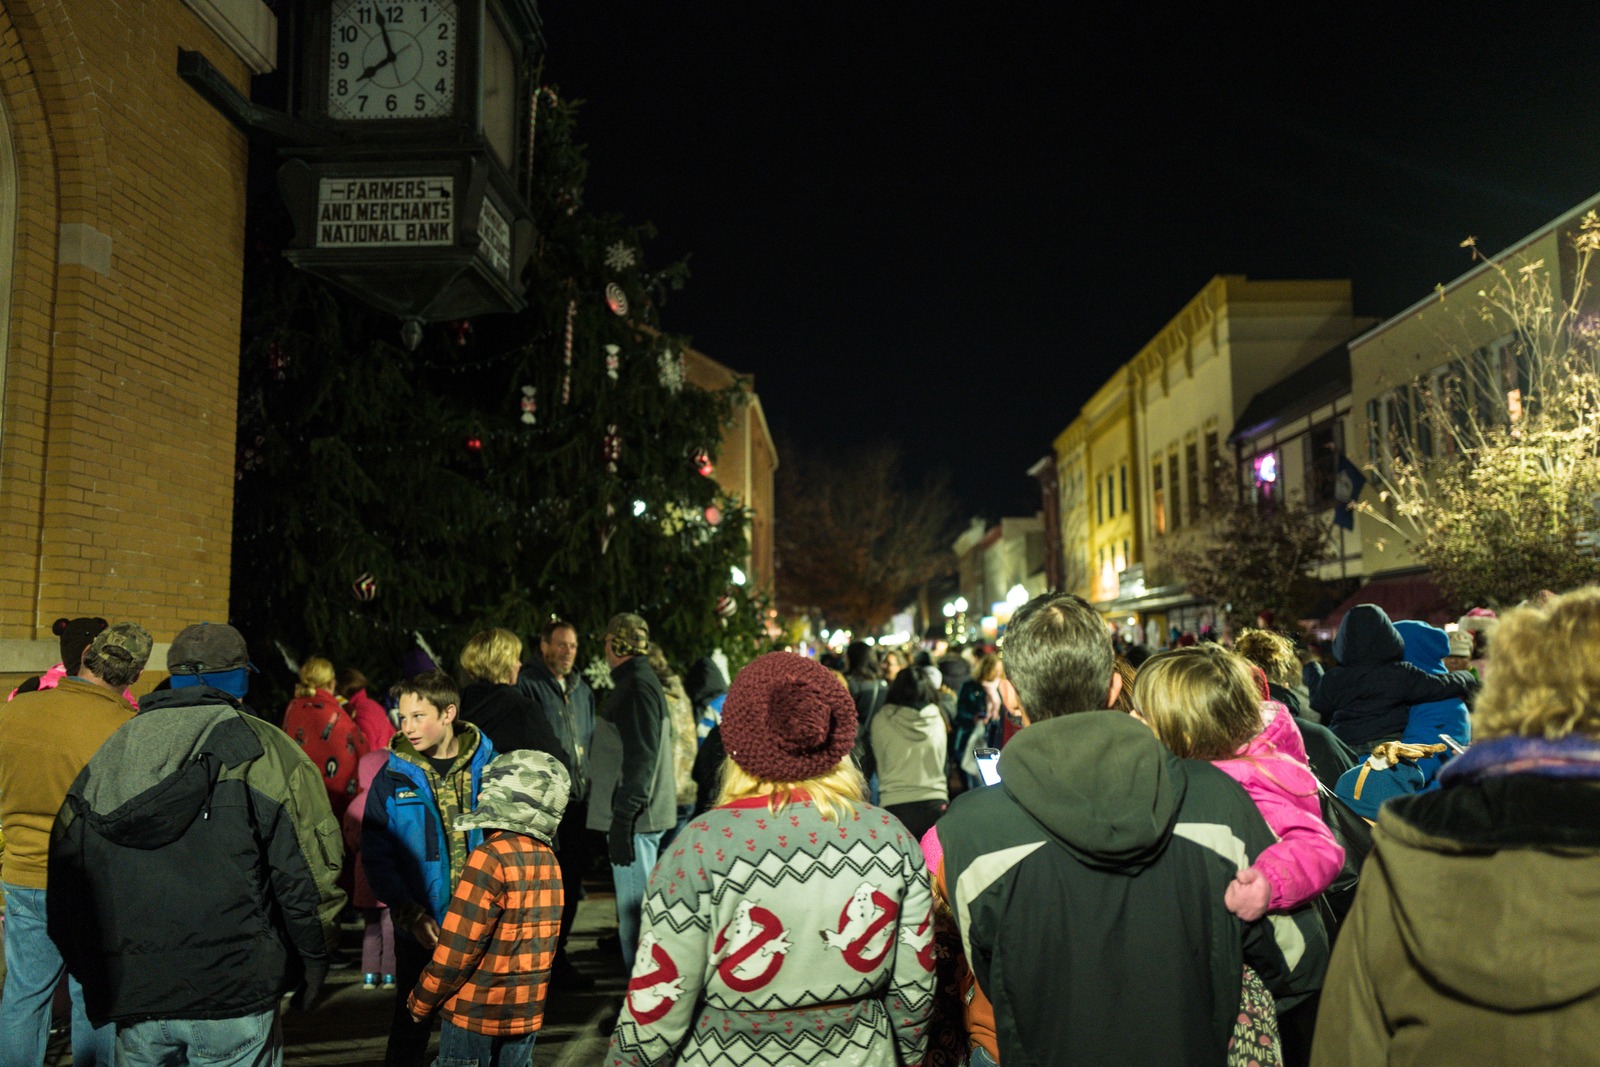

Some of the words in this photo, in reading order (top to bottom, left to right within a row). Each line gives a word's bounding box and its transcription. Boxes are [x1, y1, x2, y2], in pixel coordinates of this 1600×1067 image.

[357, 7, 371, 24] 11
[386, 6, 403, 23] 12
[420, 6, 428, 22] 1
[339, 25, 358, 42] 10
[438, 23, 448, 40] 2
[338, 52, 349, 69] 9
[437, 50, 447, 67] 3
[337, 79, 348, 96] 8
[435, 78, 446, 94] 4
[358, 95, 369, 112] 7
[386, 94, 397, 111] 6
[414, 94, 425, 111] 5
[321, 203, 352, 220] AND
[357, 202, 450, 220] MERCHANTS
[322, 224, 401, 242] NATIONAL
[406, 223, 449, 241] BANK
[1235, 1040, 1273, 1063] MINNIE
